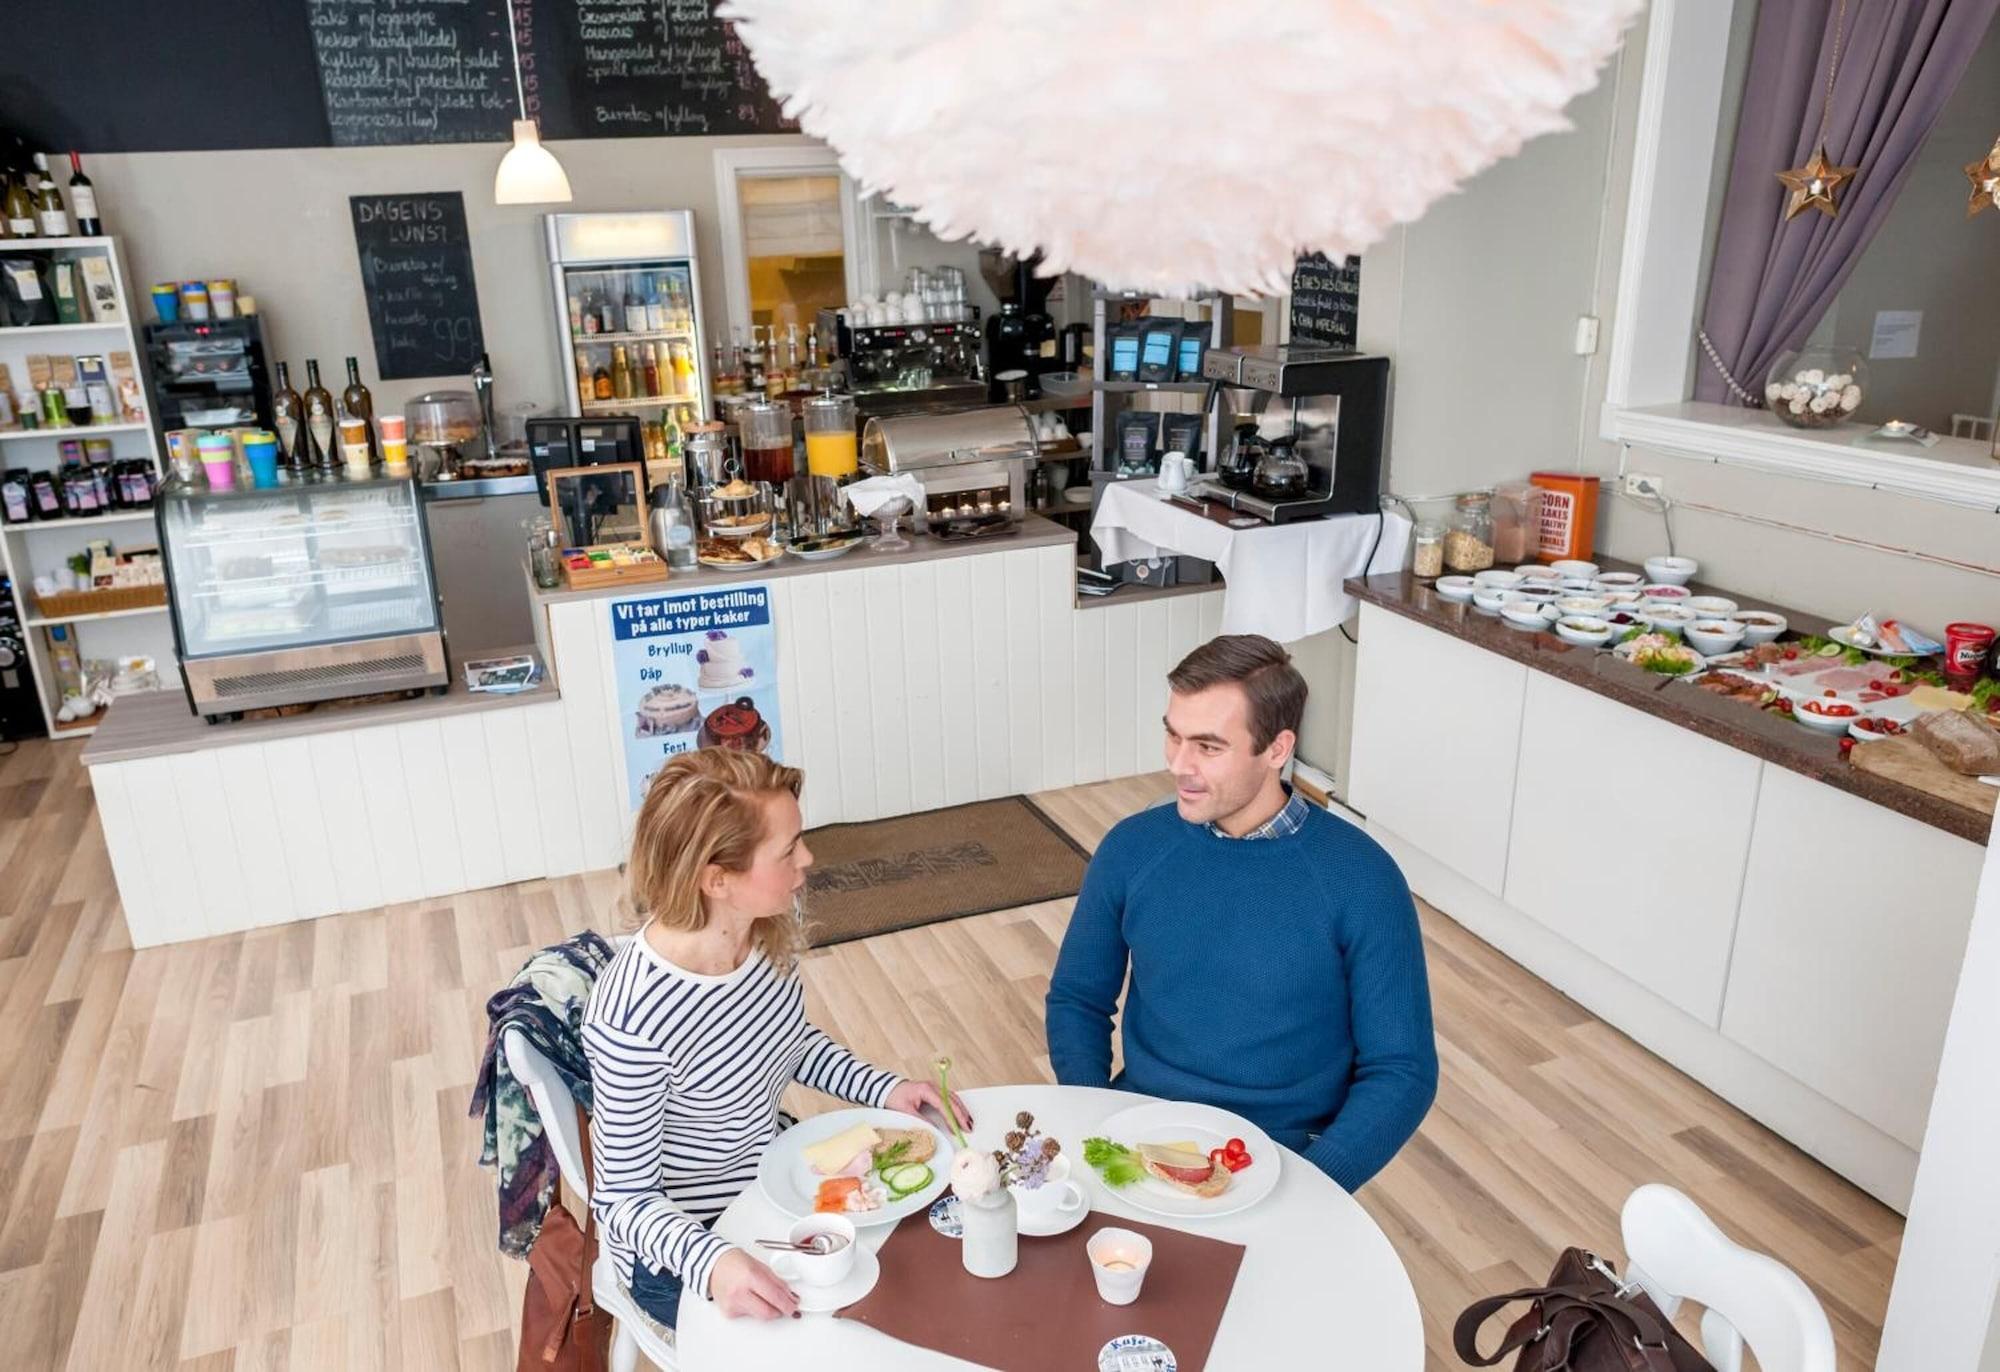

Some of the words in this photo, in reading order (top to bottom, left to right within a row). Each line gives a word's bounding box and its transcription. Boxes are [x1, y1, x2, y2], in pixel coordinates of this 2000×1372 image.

[358, 200, 443, 223] DAGENS
[1541, 508, 1569, 521] LAKES
[617, 604, 634, 620] Vi
[637, 603, 660, 618] tar
[663, 599, 697, 615] imot
[700, 592, 766, 610] bestilling
[631, 620, 648, 637] på
[650, 617, 674, 632] alle
[675, 615, 711, 632] typer
[714, 610, 751, 624] kaker
[648, 641, 694, 658] Bryllup
[640, 667, 662, 681] Dåp
[663, 742, 687, 754] Fest
